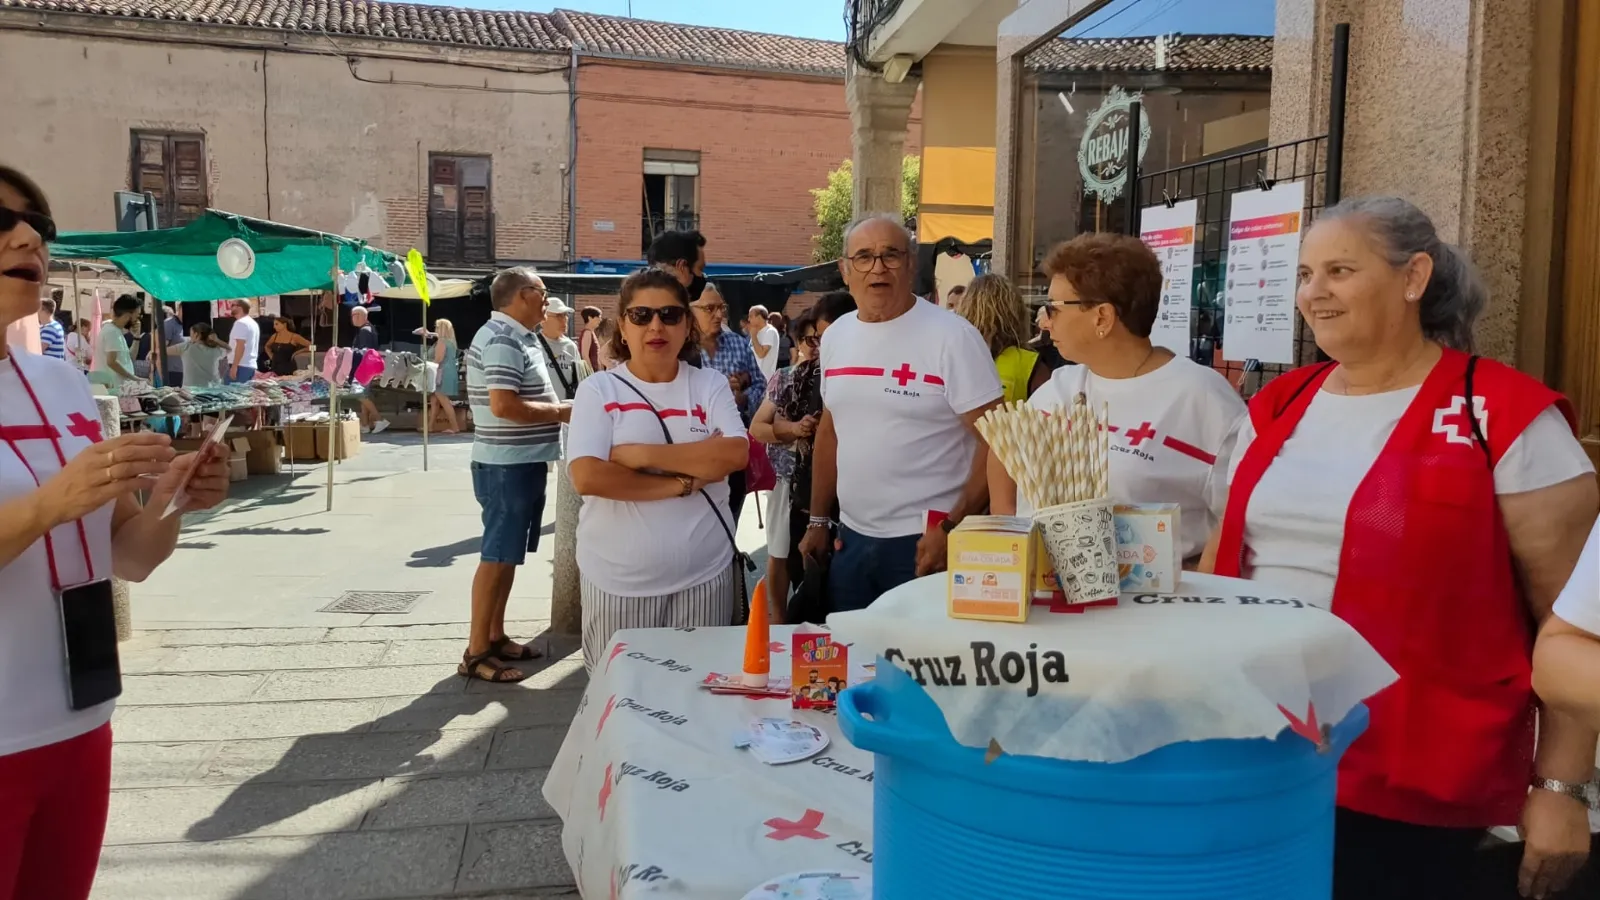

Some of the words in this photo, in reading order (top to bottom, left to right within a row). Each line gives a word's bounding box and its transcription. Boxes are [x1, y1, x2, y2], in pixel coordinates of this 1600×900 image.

[1088, 126, 1129, 166] REBAJA
[884, 387, 900, 395] Cruz
[903, 390, 920, 398] Roja
[1110, 445, 1130, 453] Cruz
[1131, 448, 1155, 462] Roja
[1117, 550, 1139, 559] ADA
[1133, 593, 1226, 605] Cruz
[657, 659, 693, 673] Roja
[970, 641, 1069, 697] Roja
[647, 710, 688, 726] Roja
[812, 756, 861, 776] Cruz
[642, 771, 690, 792] Roja
[836, 841, 874, 863] Cru
